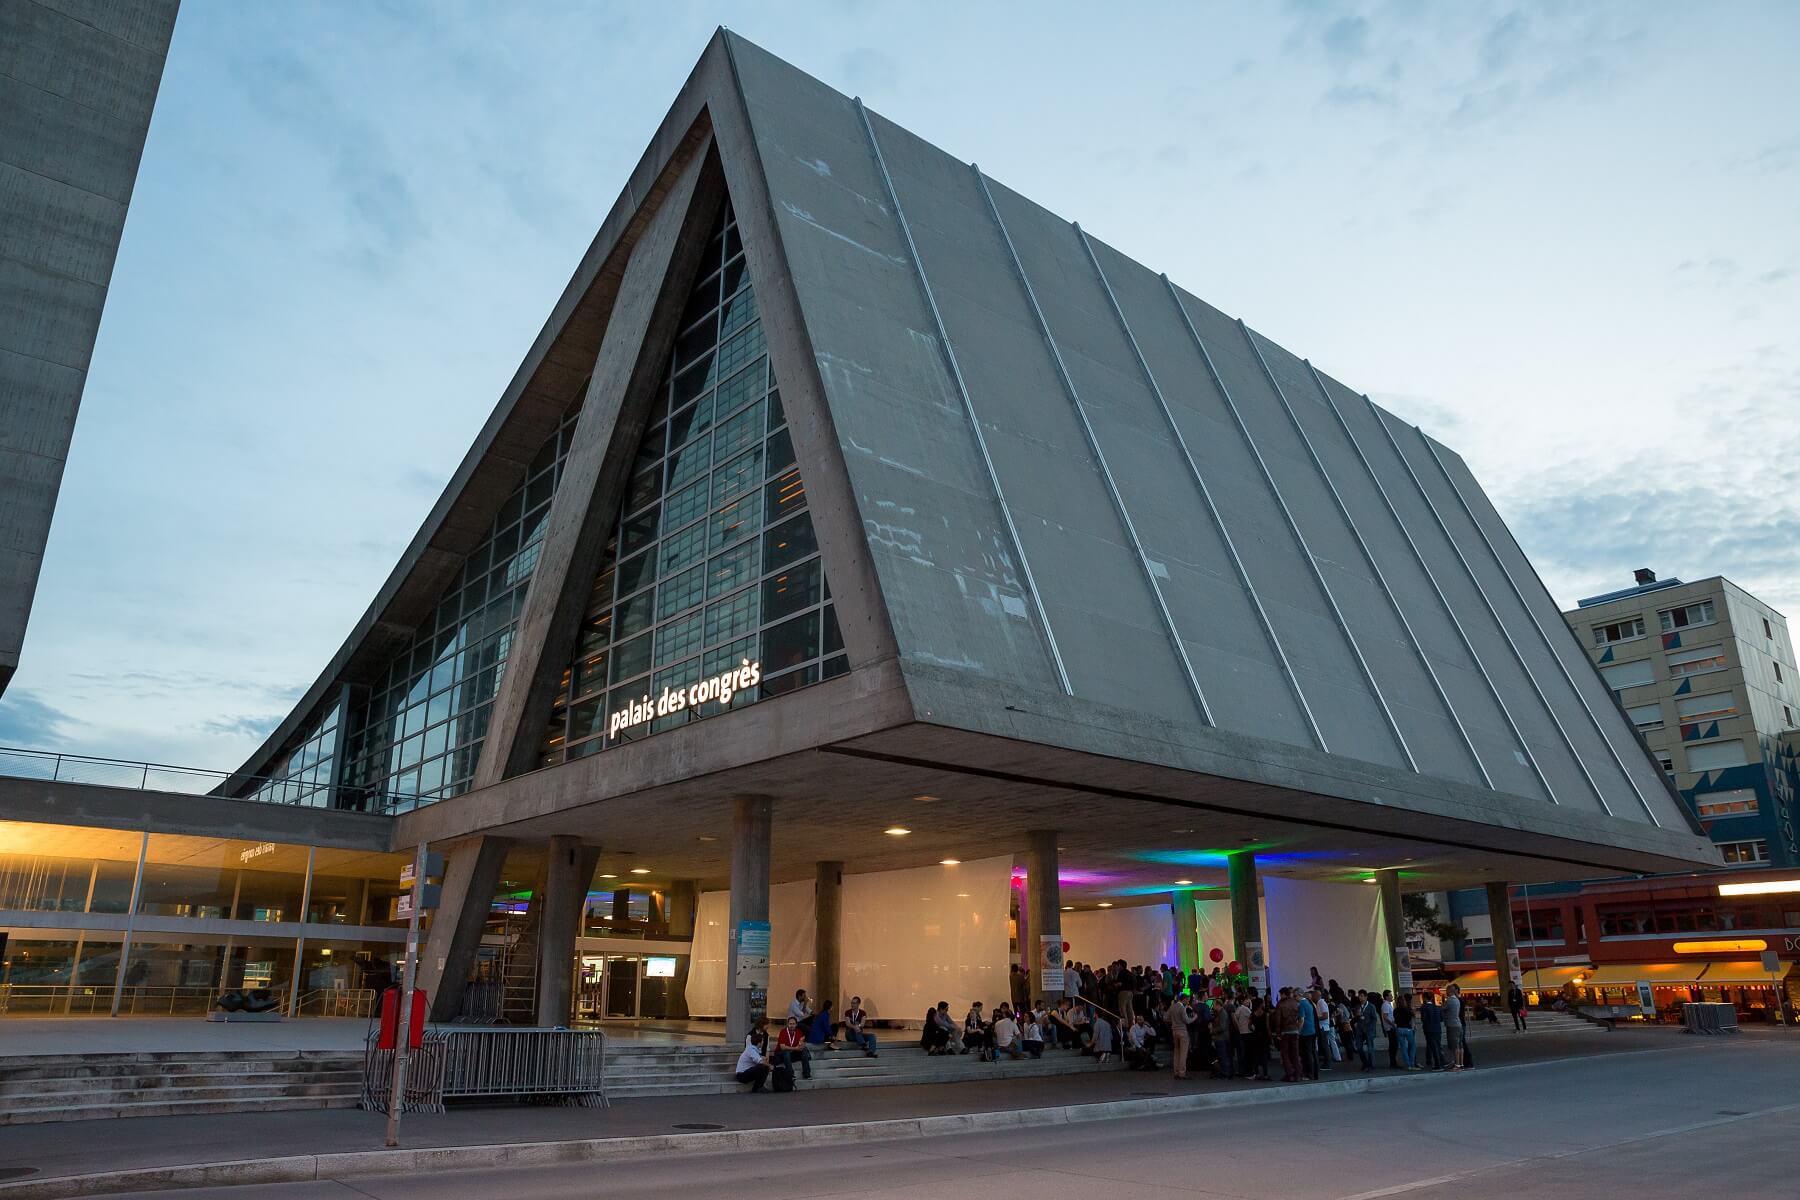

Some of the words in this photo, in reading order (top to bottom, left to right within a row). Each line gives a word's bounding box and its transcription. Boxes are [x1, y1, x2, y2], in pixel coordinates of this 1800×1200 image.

[610, 694, 654, 740] palais
[657, 686, 686, 717] des
[689, 658, 760, 704] congrès
